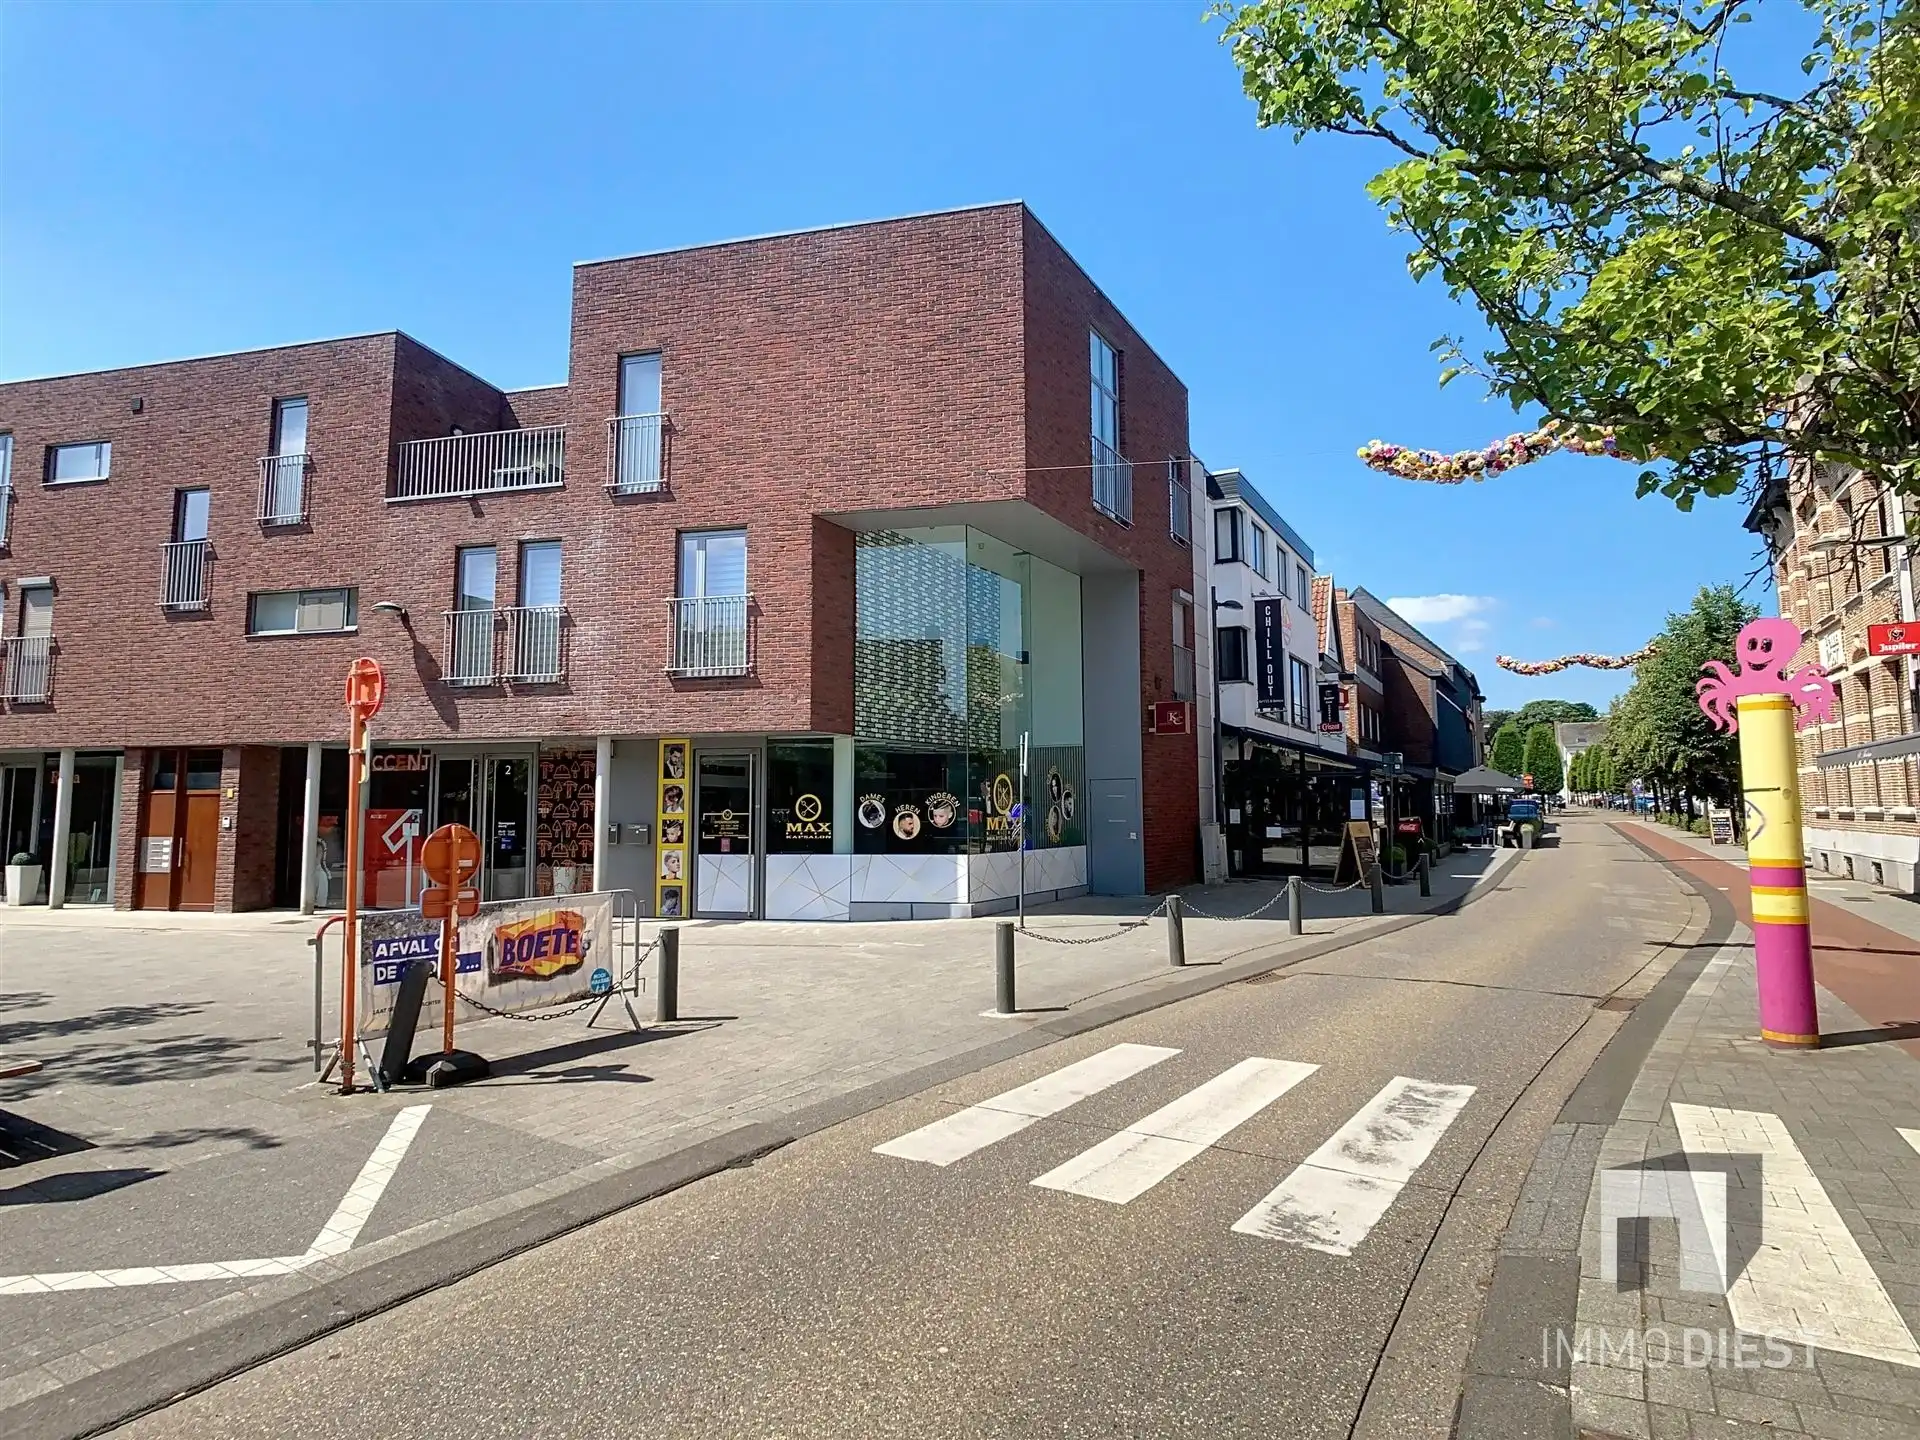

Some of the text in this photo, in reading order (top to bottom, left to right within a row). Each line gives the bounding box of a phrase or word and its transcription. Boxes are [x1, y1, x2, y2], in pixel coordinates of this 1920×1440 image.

[1879, 641, 1919, 653] Jupiler
[372, 754, 430, 771] CCENT
[505, 766, 511, 775] 2
[859, 793, 885, 803] DAMES
[925, 792, 960, 808] KINDEREN
[895, 804, 920, 814] HEREN
[786, 822, 831, 832] MAX
[375, 939, 429, 958] AFVAL
[500, 928, 579, 967] BOETE
[376, 965, 397, 981] DE
